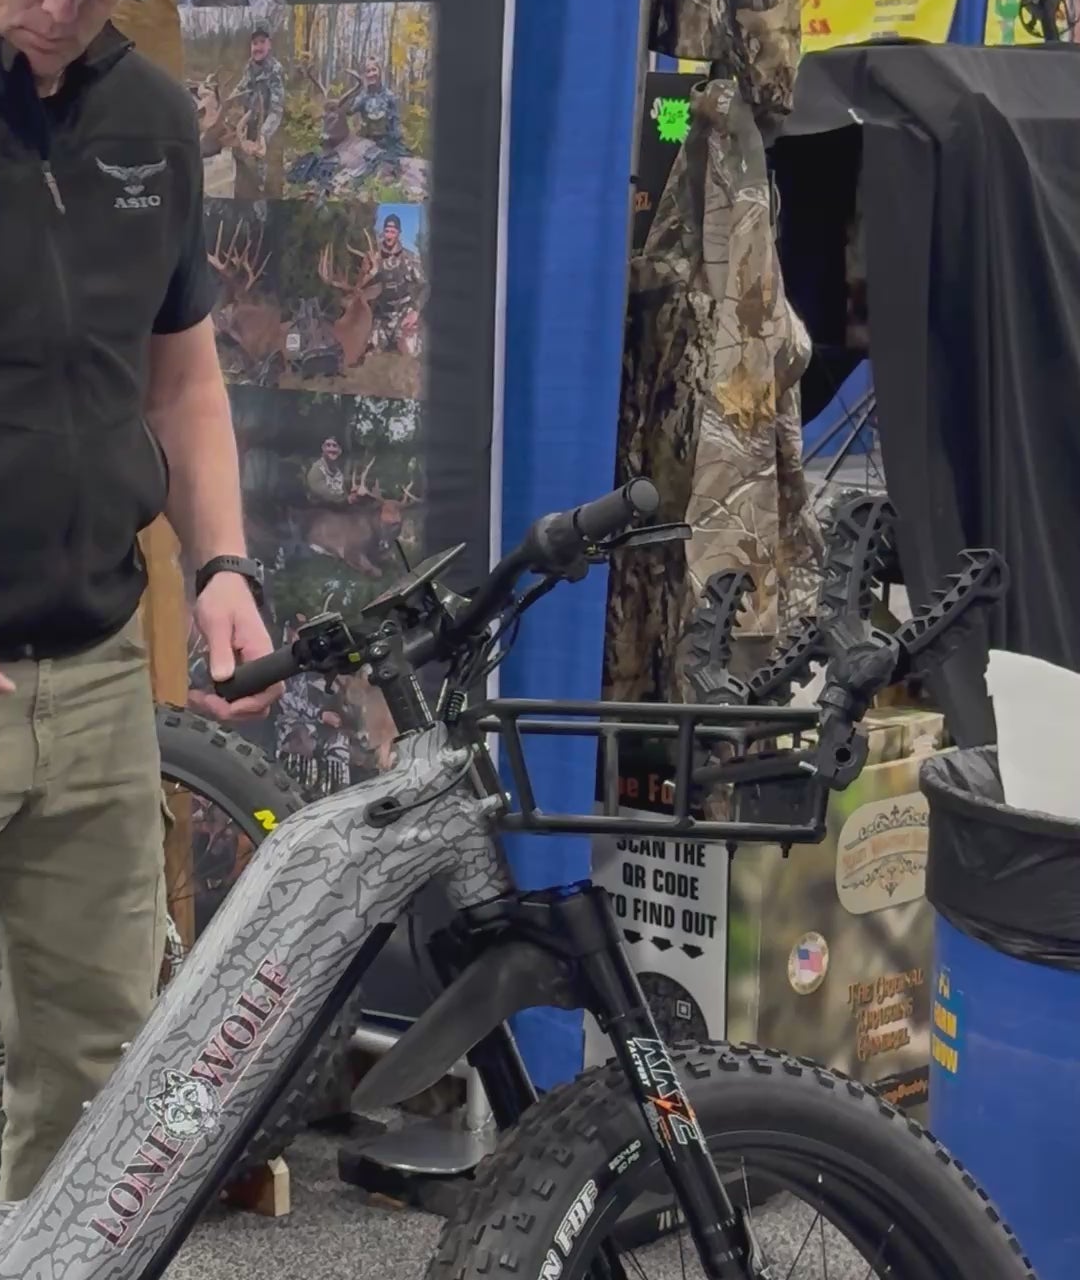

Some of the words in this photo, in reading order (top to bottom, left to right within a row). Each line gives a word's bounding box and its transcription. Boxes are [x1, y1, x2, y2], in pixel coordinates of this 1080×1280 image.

[114, 195, 161, 208] ASIO
[675, 841, 706, 867] THE
[622, 862, 646, 889] QR
[653, 869, 699, 900] CODE
[633, 898, 675, 929] FIND
[682, 909, 717, 939] OUT
[87, 1123, 187, 1249] LONE
[189, 958, 290, 1088] WOLF
